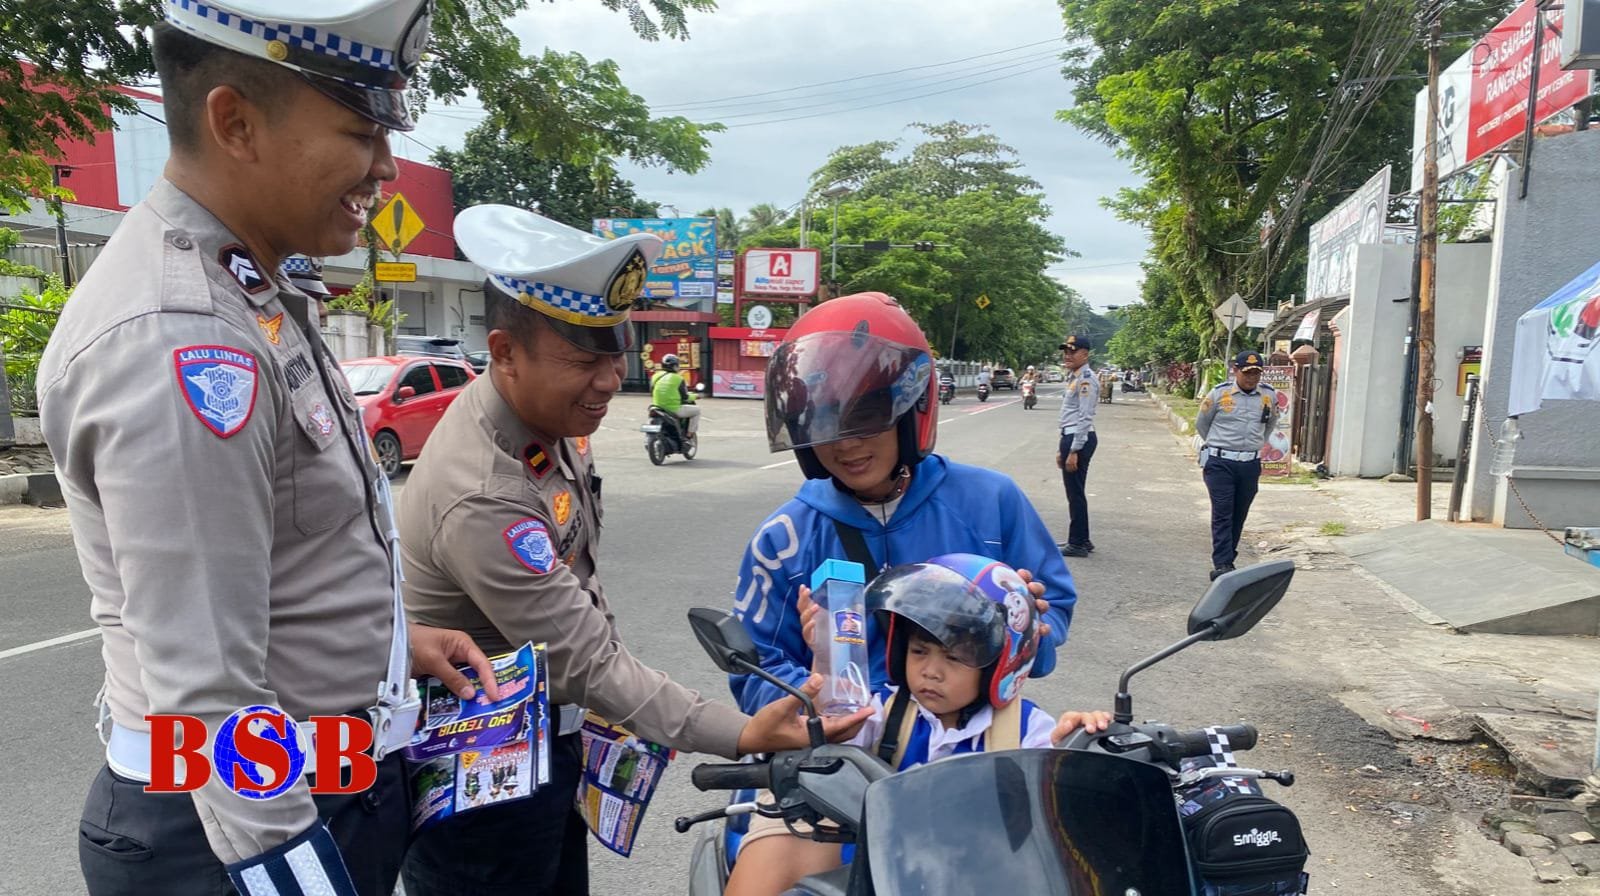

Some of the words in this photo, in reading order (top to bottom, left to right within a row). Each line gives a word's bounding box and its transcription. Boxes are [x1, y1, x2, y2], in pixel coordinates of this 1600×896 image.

[180, 350, 209, 361] LALU
[214, 350, 253, 367] LINTAS
[487, 712, 515, 728] AYO
